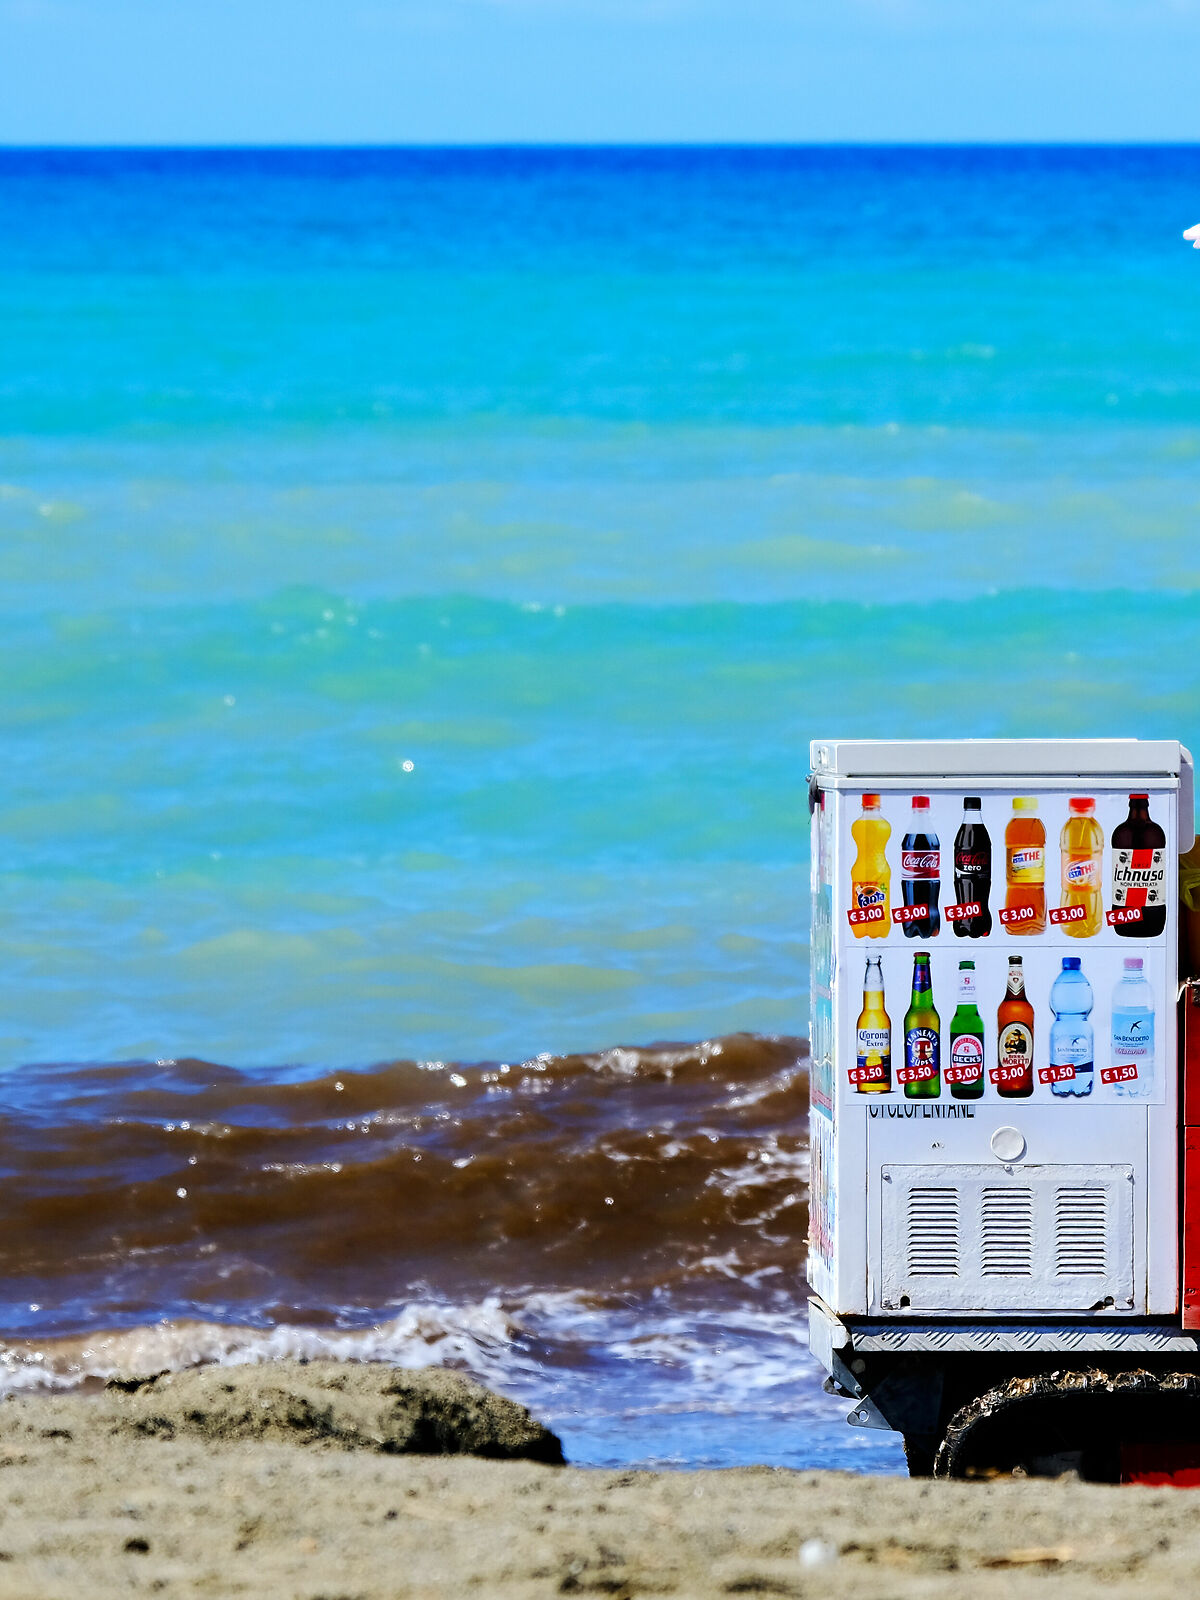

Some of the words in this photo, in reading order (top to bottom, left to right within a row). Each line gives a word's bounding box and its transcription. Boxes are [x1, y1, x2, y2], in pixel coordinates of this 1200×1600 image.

[903, 853, 938, 868] Coca-Cola
[860, 908, 882, 921] 3,00
[904, 906, 927, 919] 3,00
[956, 904, 980, 918] 3,00
[1010, 907, 1034, 920] 3,00
[1060, 907, 1084, 920] 3,00
[1118, 909, 1140, 922] 4,00
[859, 1030, 888, 1040] Corona
[953, 1055, 981, 1063] BECK'S
[860, 1067, 882, 1080] 3,50
[908, 1066, 931, 1079] 3,50
[956, 1067, 979, 1080] 3,00
[1001, 1067, 1024, 1080] 3,00
[1051, 1067, 1073, 1080] 1,50
[1113, 1067, 1135, 1080] 1,50
